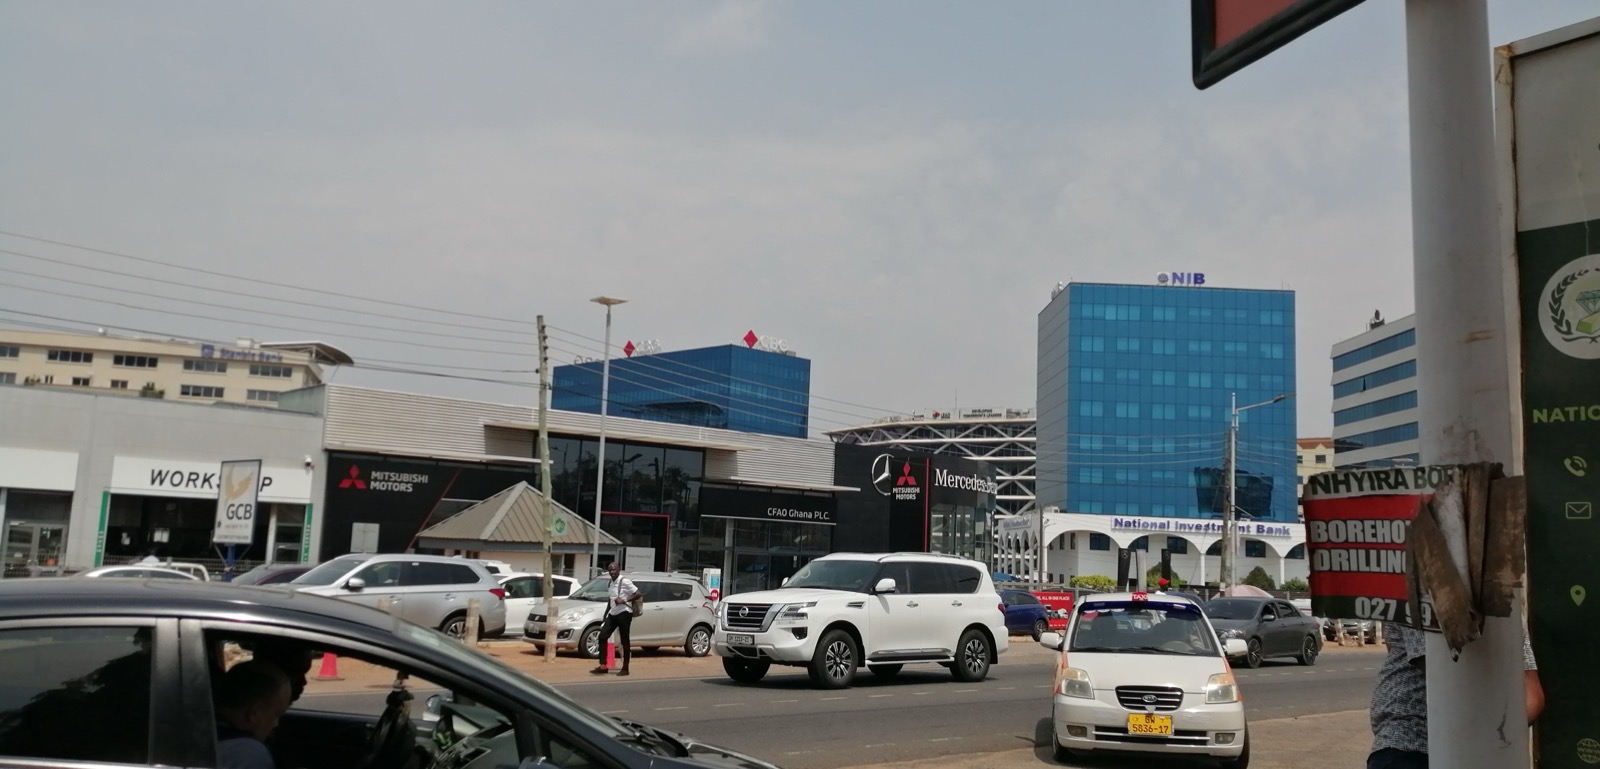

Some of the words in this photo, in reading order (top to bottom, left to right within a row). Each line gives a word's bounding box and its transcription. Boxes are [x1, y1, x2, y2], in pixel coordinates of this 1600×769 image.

[1171, 272, 1206, 285] NIB
[371, 471, 429, 483] MITSUBISHI
[1311, 469, 1409, 494] NHYIRA
[370, 481, 413, 492] MOTORS
[892, 486, 921, 495] MITSUBISHI
[895, 493, 917, 501] MOTORS
[226, 503, 252, 520] GCB
[767, 507, 788, 517] CFAO
[788, 508, 813, 519] Ghana
[814, 510, 830, 520] PLC.
[1113, 518, 1170, 530] National
[1175, 520, 1251, 535] Investmnt
[1256, 524, 1291, 536] Bank
[1309, 519, 1411, 543] BOREHO
[1355, 597, 1397, 621] 027
[1132, 724, 1169, 734] 5836-17
